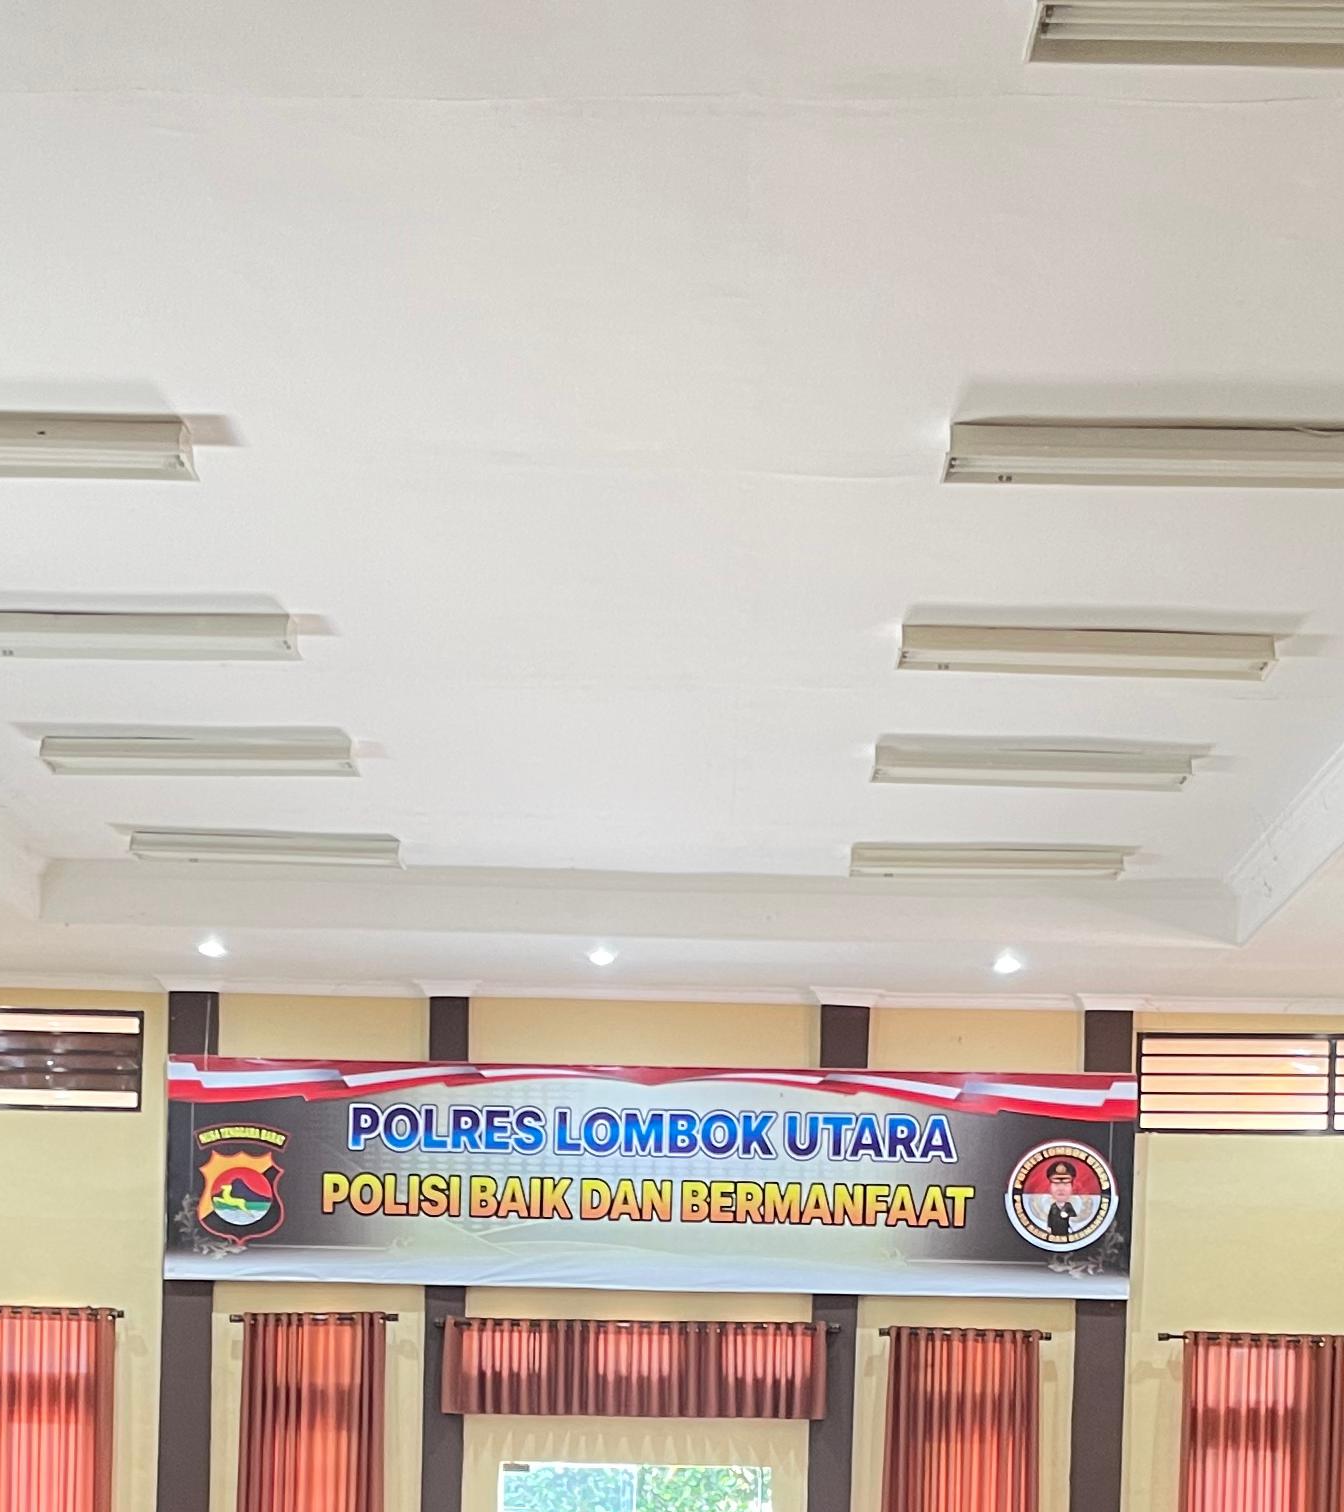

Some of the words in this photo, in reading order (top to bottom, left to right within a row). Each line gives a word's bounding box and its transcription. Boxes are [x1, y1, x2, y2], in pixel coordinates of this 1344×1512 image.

[349, 1103, 546, 1155] POLRES
[554, 1106, 777, 1160] LOMBOK
[784, 1112, 958, 1163] UTARA
[322, 1171, 461, 1217] POLISI
[469, 1174, 573, 1220] BAIK
[580, 1177, 673, 1222] DAN
[680, 1180, 975, 1228] BERMANFAAT
